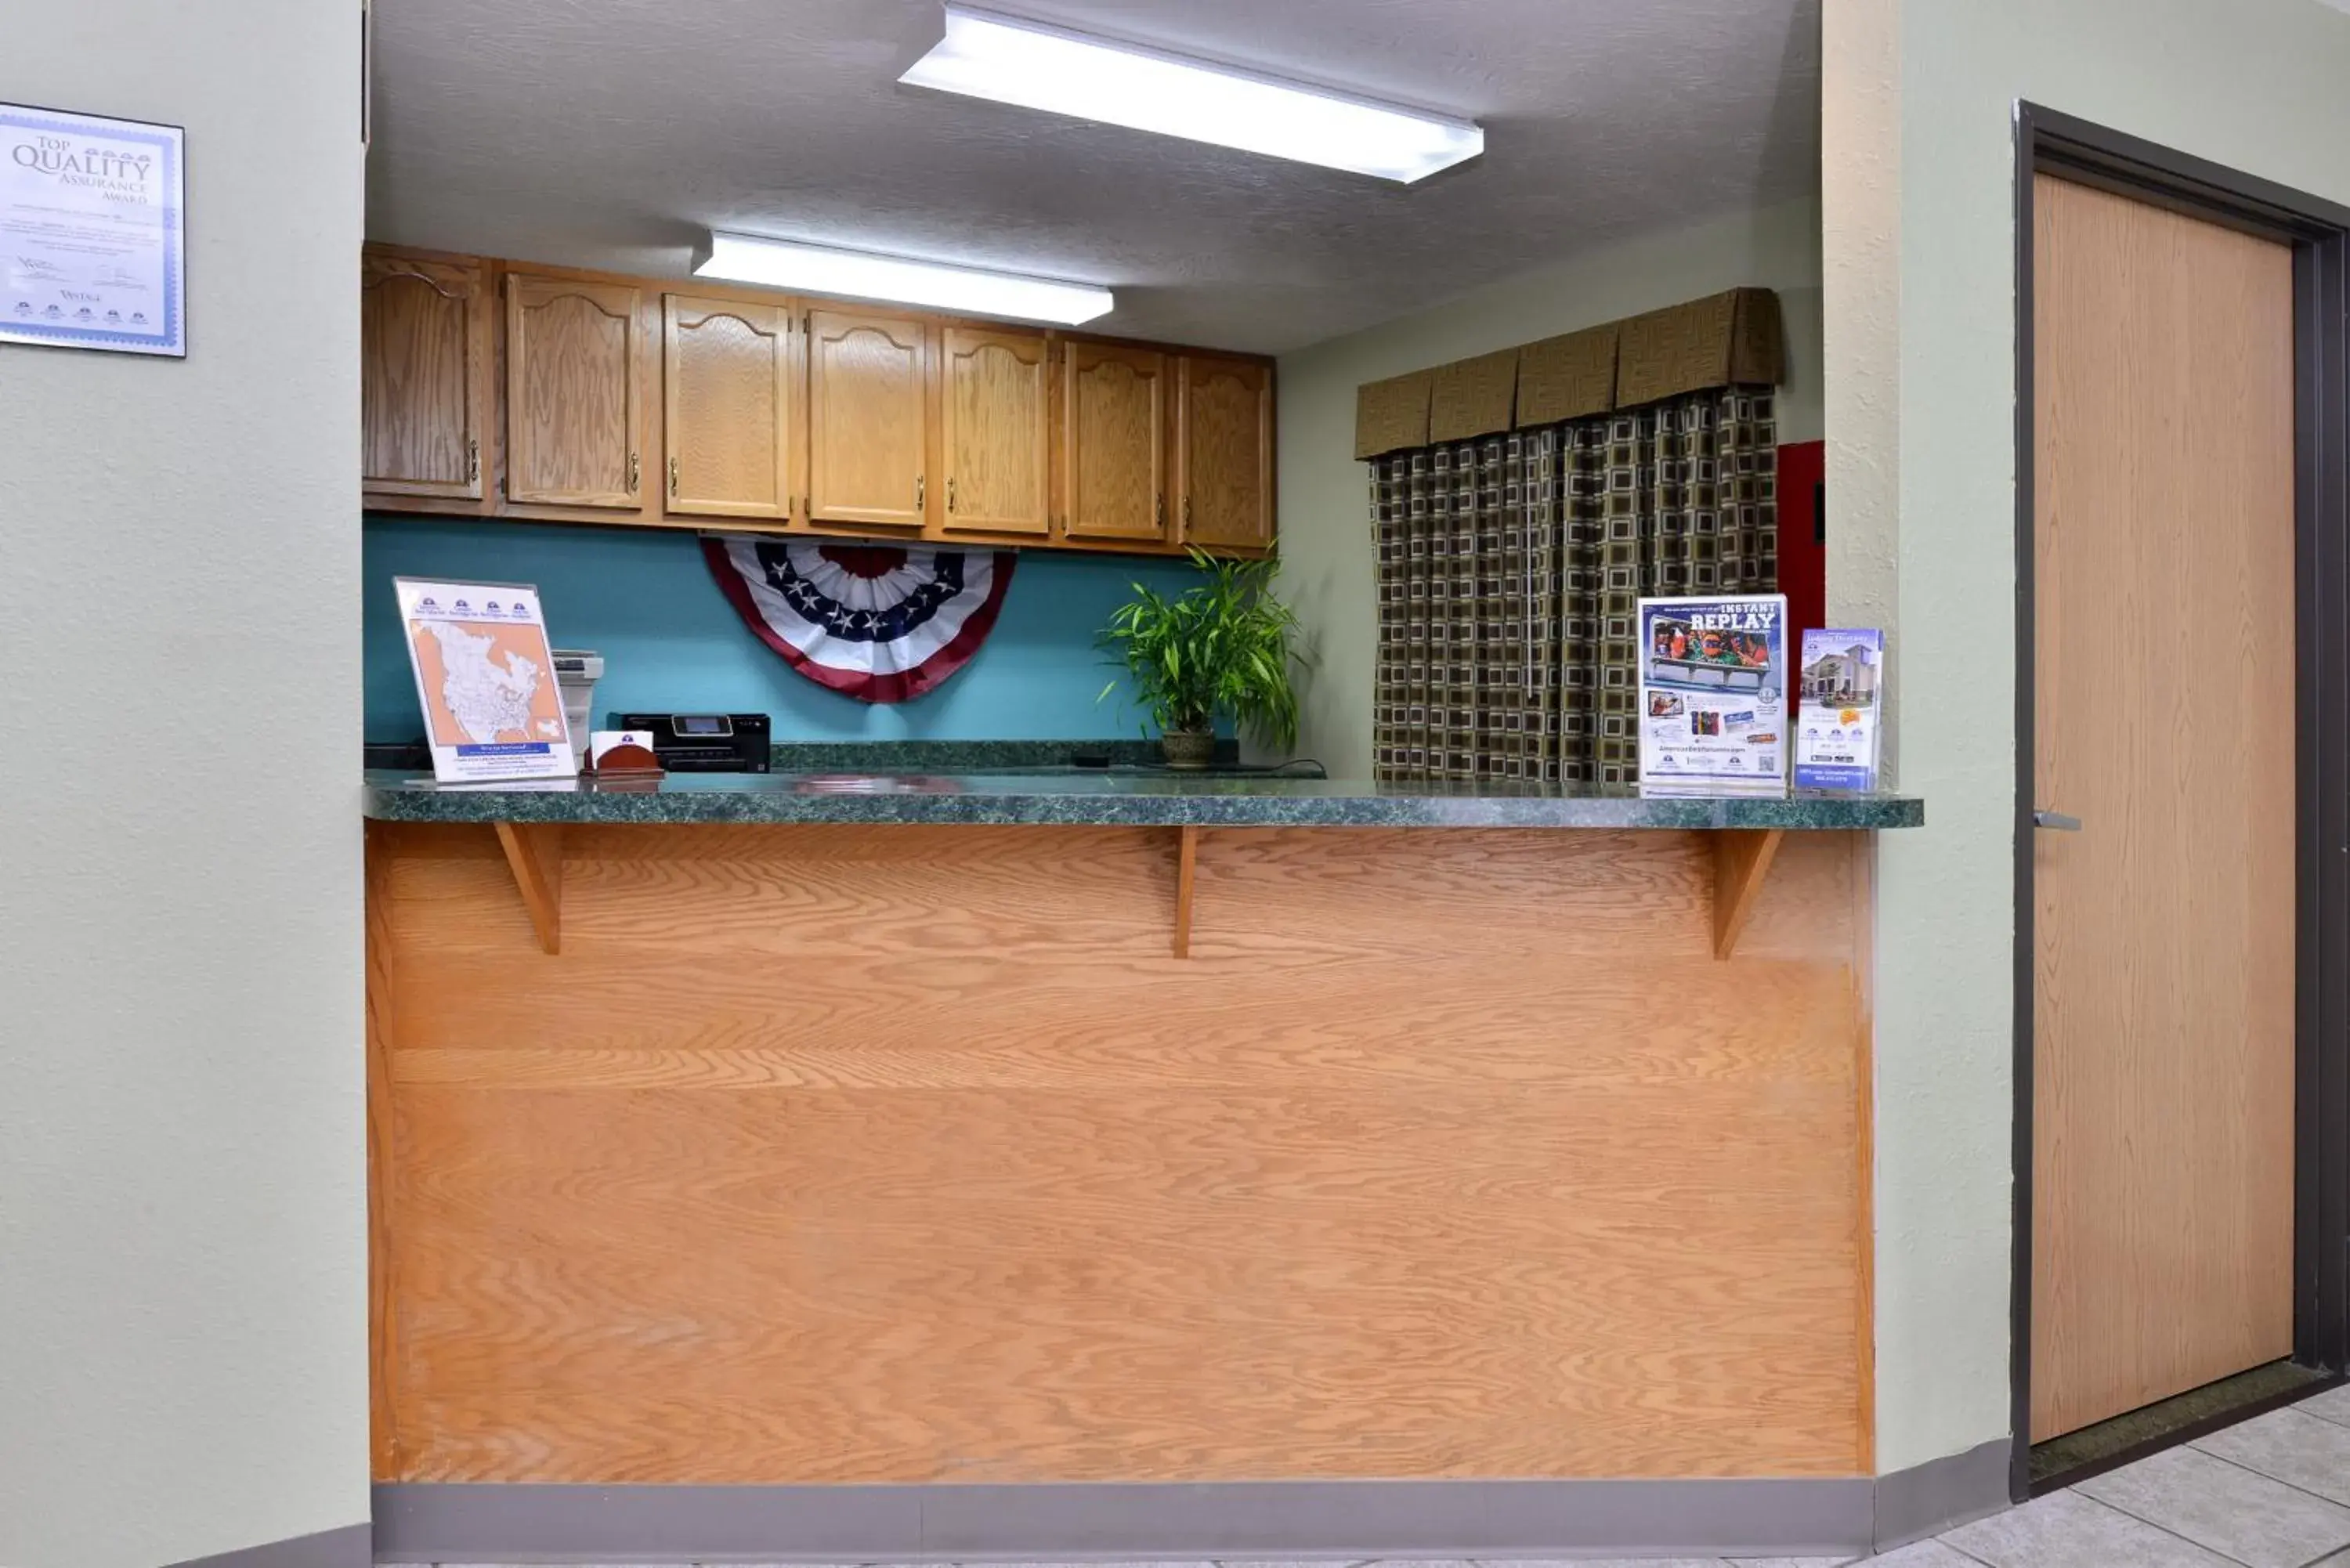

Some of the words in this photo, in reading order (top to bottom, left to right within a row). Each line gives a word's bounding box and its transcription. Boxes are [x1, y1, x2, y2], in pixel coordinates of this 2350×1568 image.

[37, 135, 70, 151] TOP
[12, 143, 150, 181] QUALITY
[60, 172, 147, 193] ASSURANCE
[102, 191, 148, 204] AWARD
[1721, 603, 1777, 614] INSTANT
[1690, 613, 1776, 630] REPLAY
